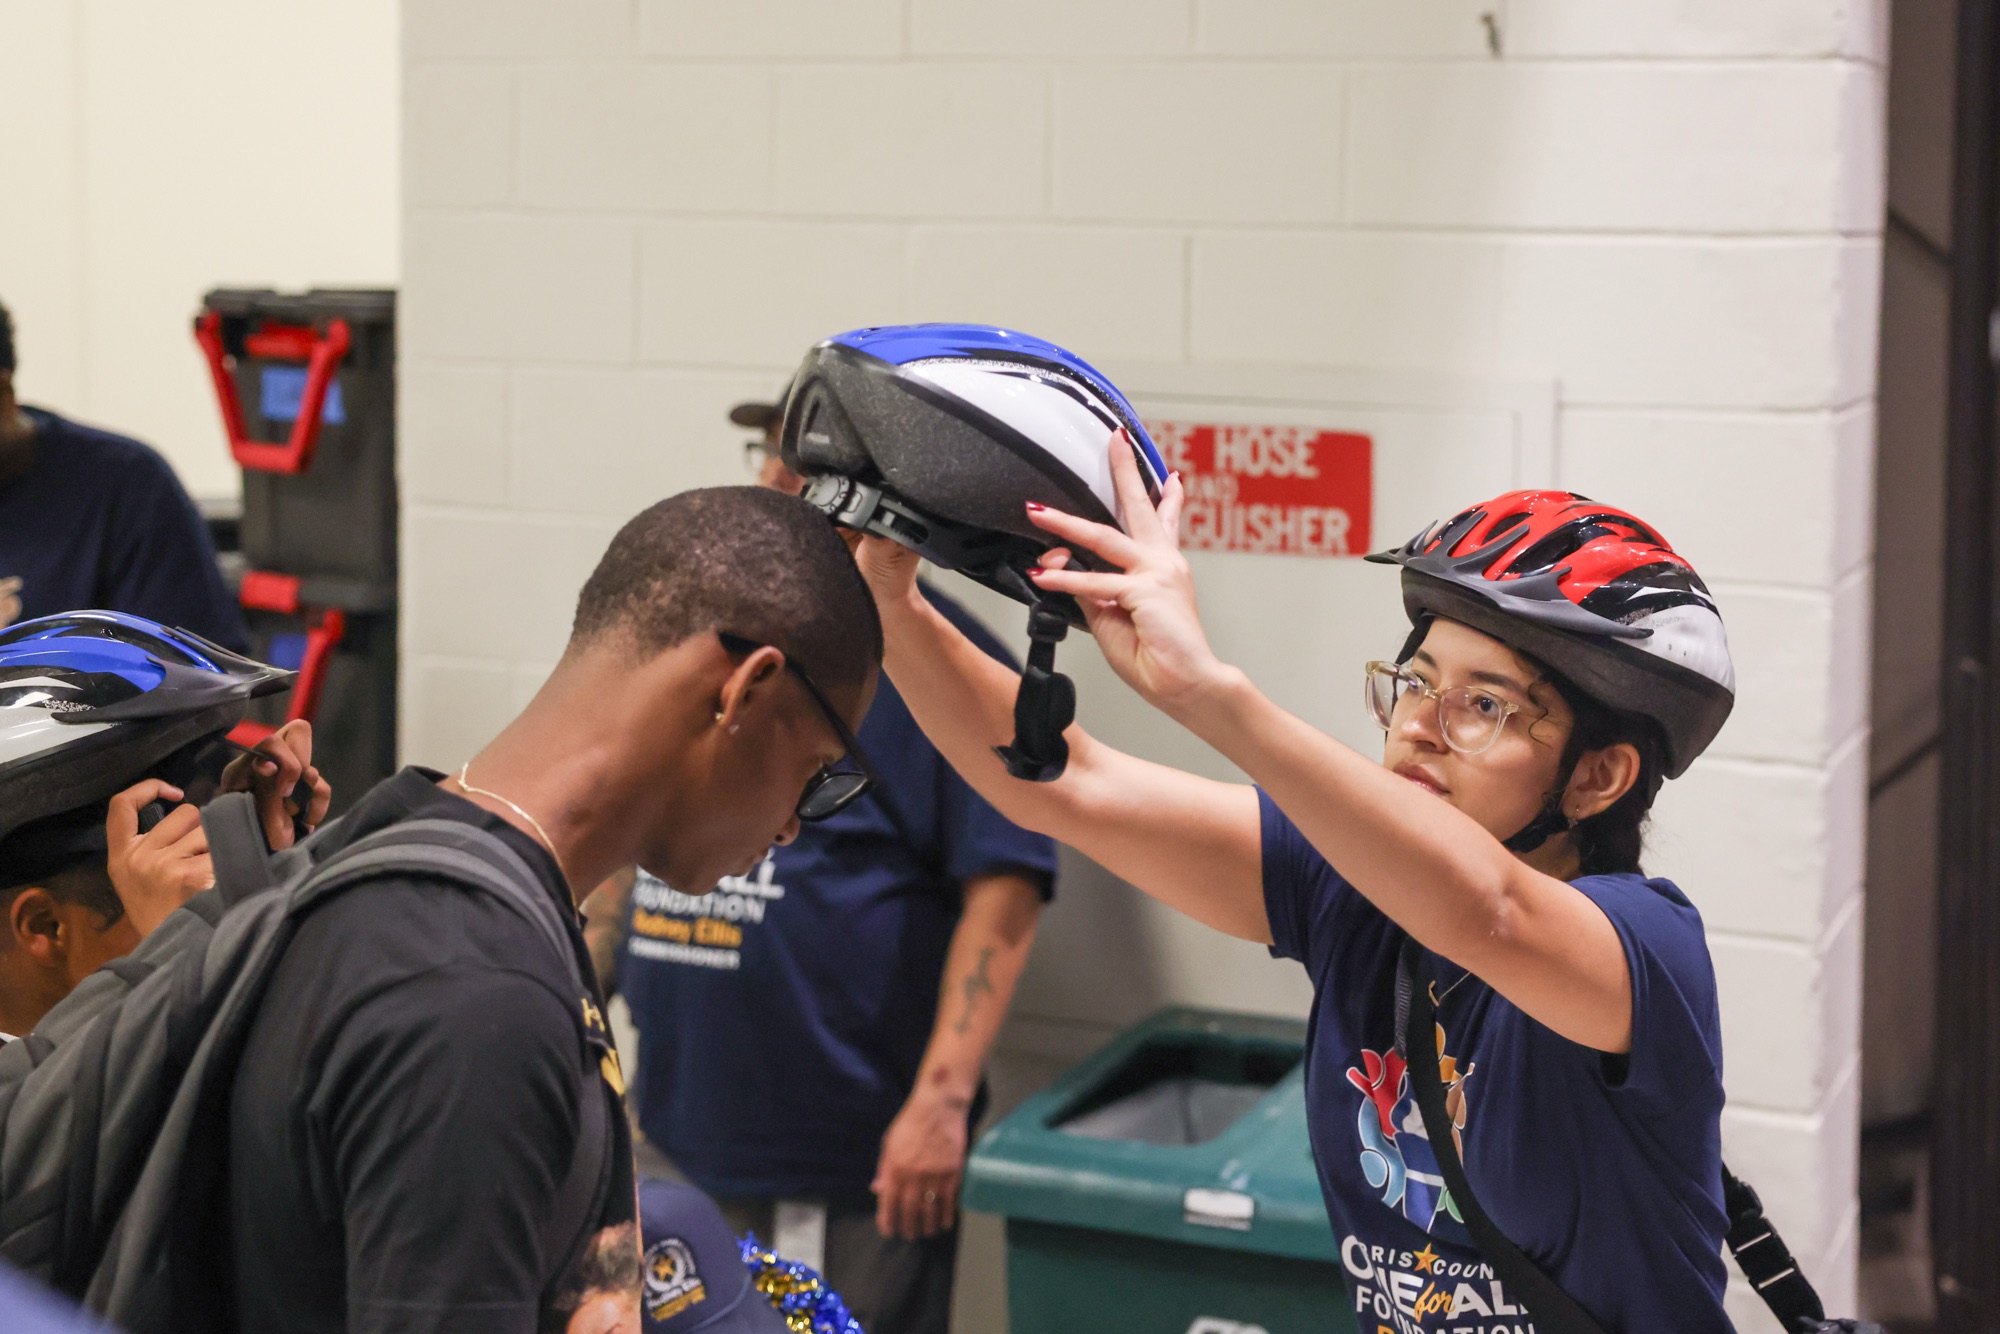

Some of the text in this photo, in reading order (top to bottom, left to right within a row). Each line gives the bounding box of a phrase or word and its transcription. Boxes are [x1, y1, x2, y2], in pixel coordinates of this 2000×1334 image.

[1214, 423, 1321, 479] HOSE
[1413, 1281, 1456, 1324] for
[1445, 1279, 1529, 1321] AL
